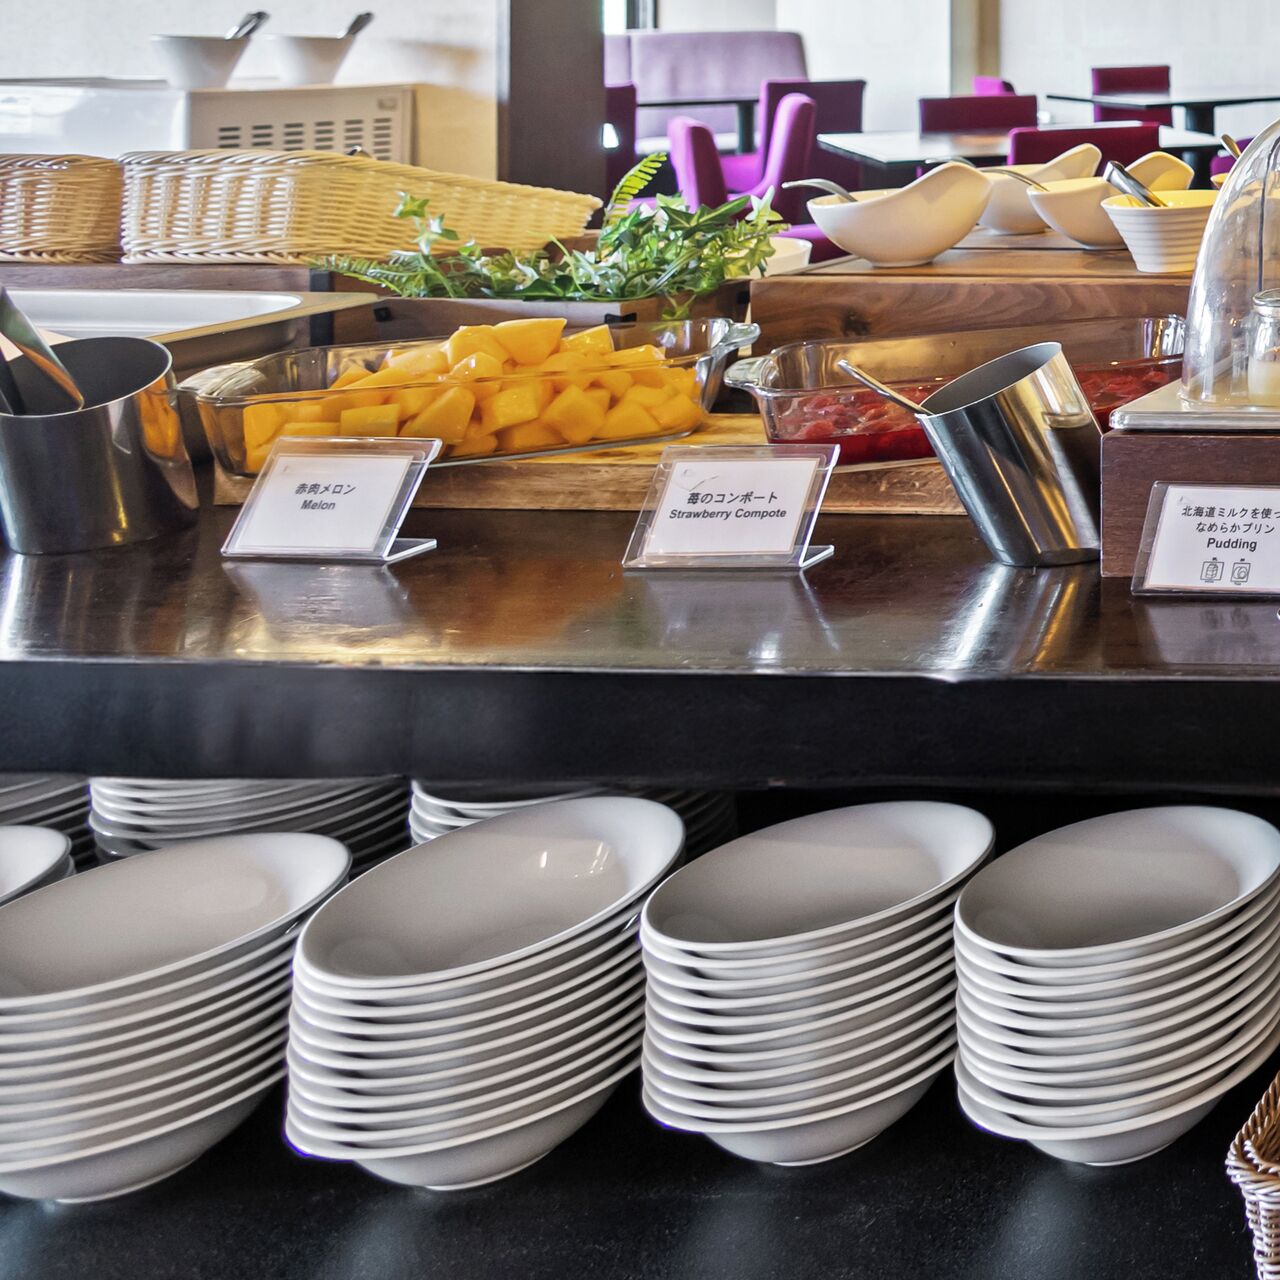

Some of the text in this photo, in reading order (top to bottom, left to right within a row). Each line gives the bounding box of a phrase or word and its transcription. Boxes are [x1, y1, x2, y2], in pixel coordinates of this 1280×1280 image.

[295, 482, 356, 495] 赤肉メロン
[300, 499, 336, 510] Melon
[669, 508, 787, 520] Strawberry Compote
[1195, 521, 1275, 535] なめらかプリン
[1206, 537, 1258, 552] Pudding
